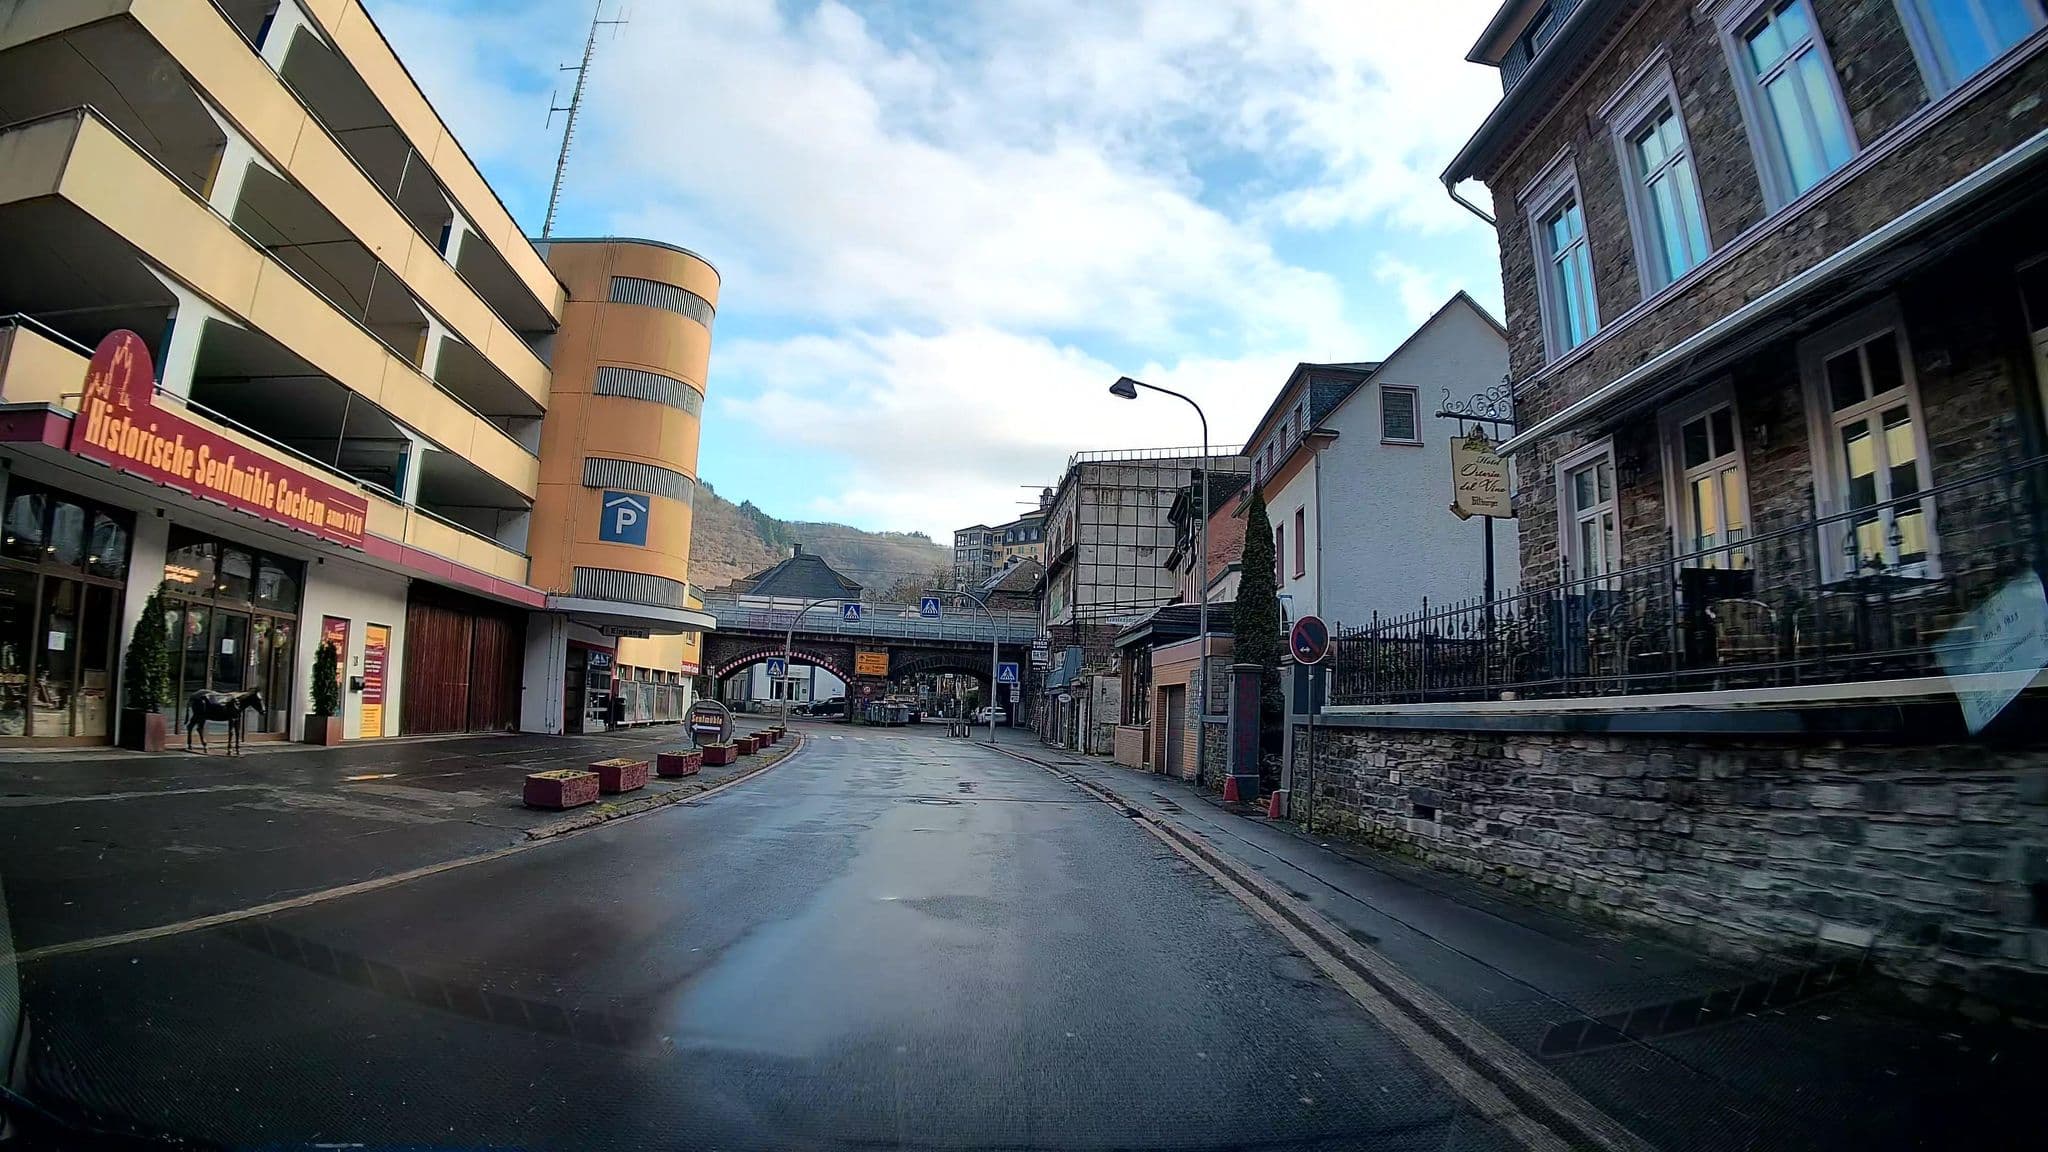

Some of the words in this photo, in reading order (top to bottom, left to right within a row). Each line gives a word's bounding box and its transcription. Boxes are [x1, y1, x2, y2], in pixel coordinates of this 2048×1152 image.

[84, 397, 194, 479] Historische
[195, 444, 275, 509] Senfmühle
[276, 478, 325, 527] Cochem
[1476, 456, 1502, 466] Hotel
[1479, 479, 1506, 493] Vino
[615, 507, 637, 534] P
